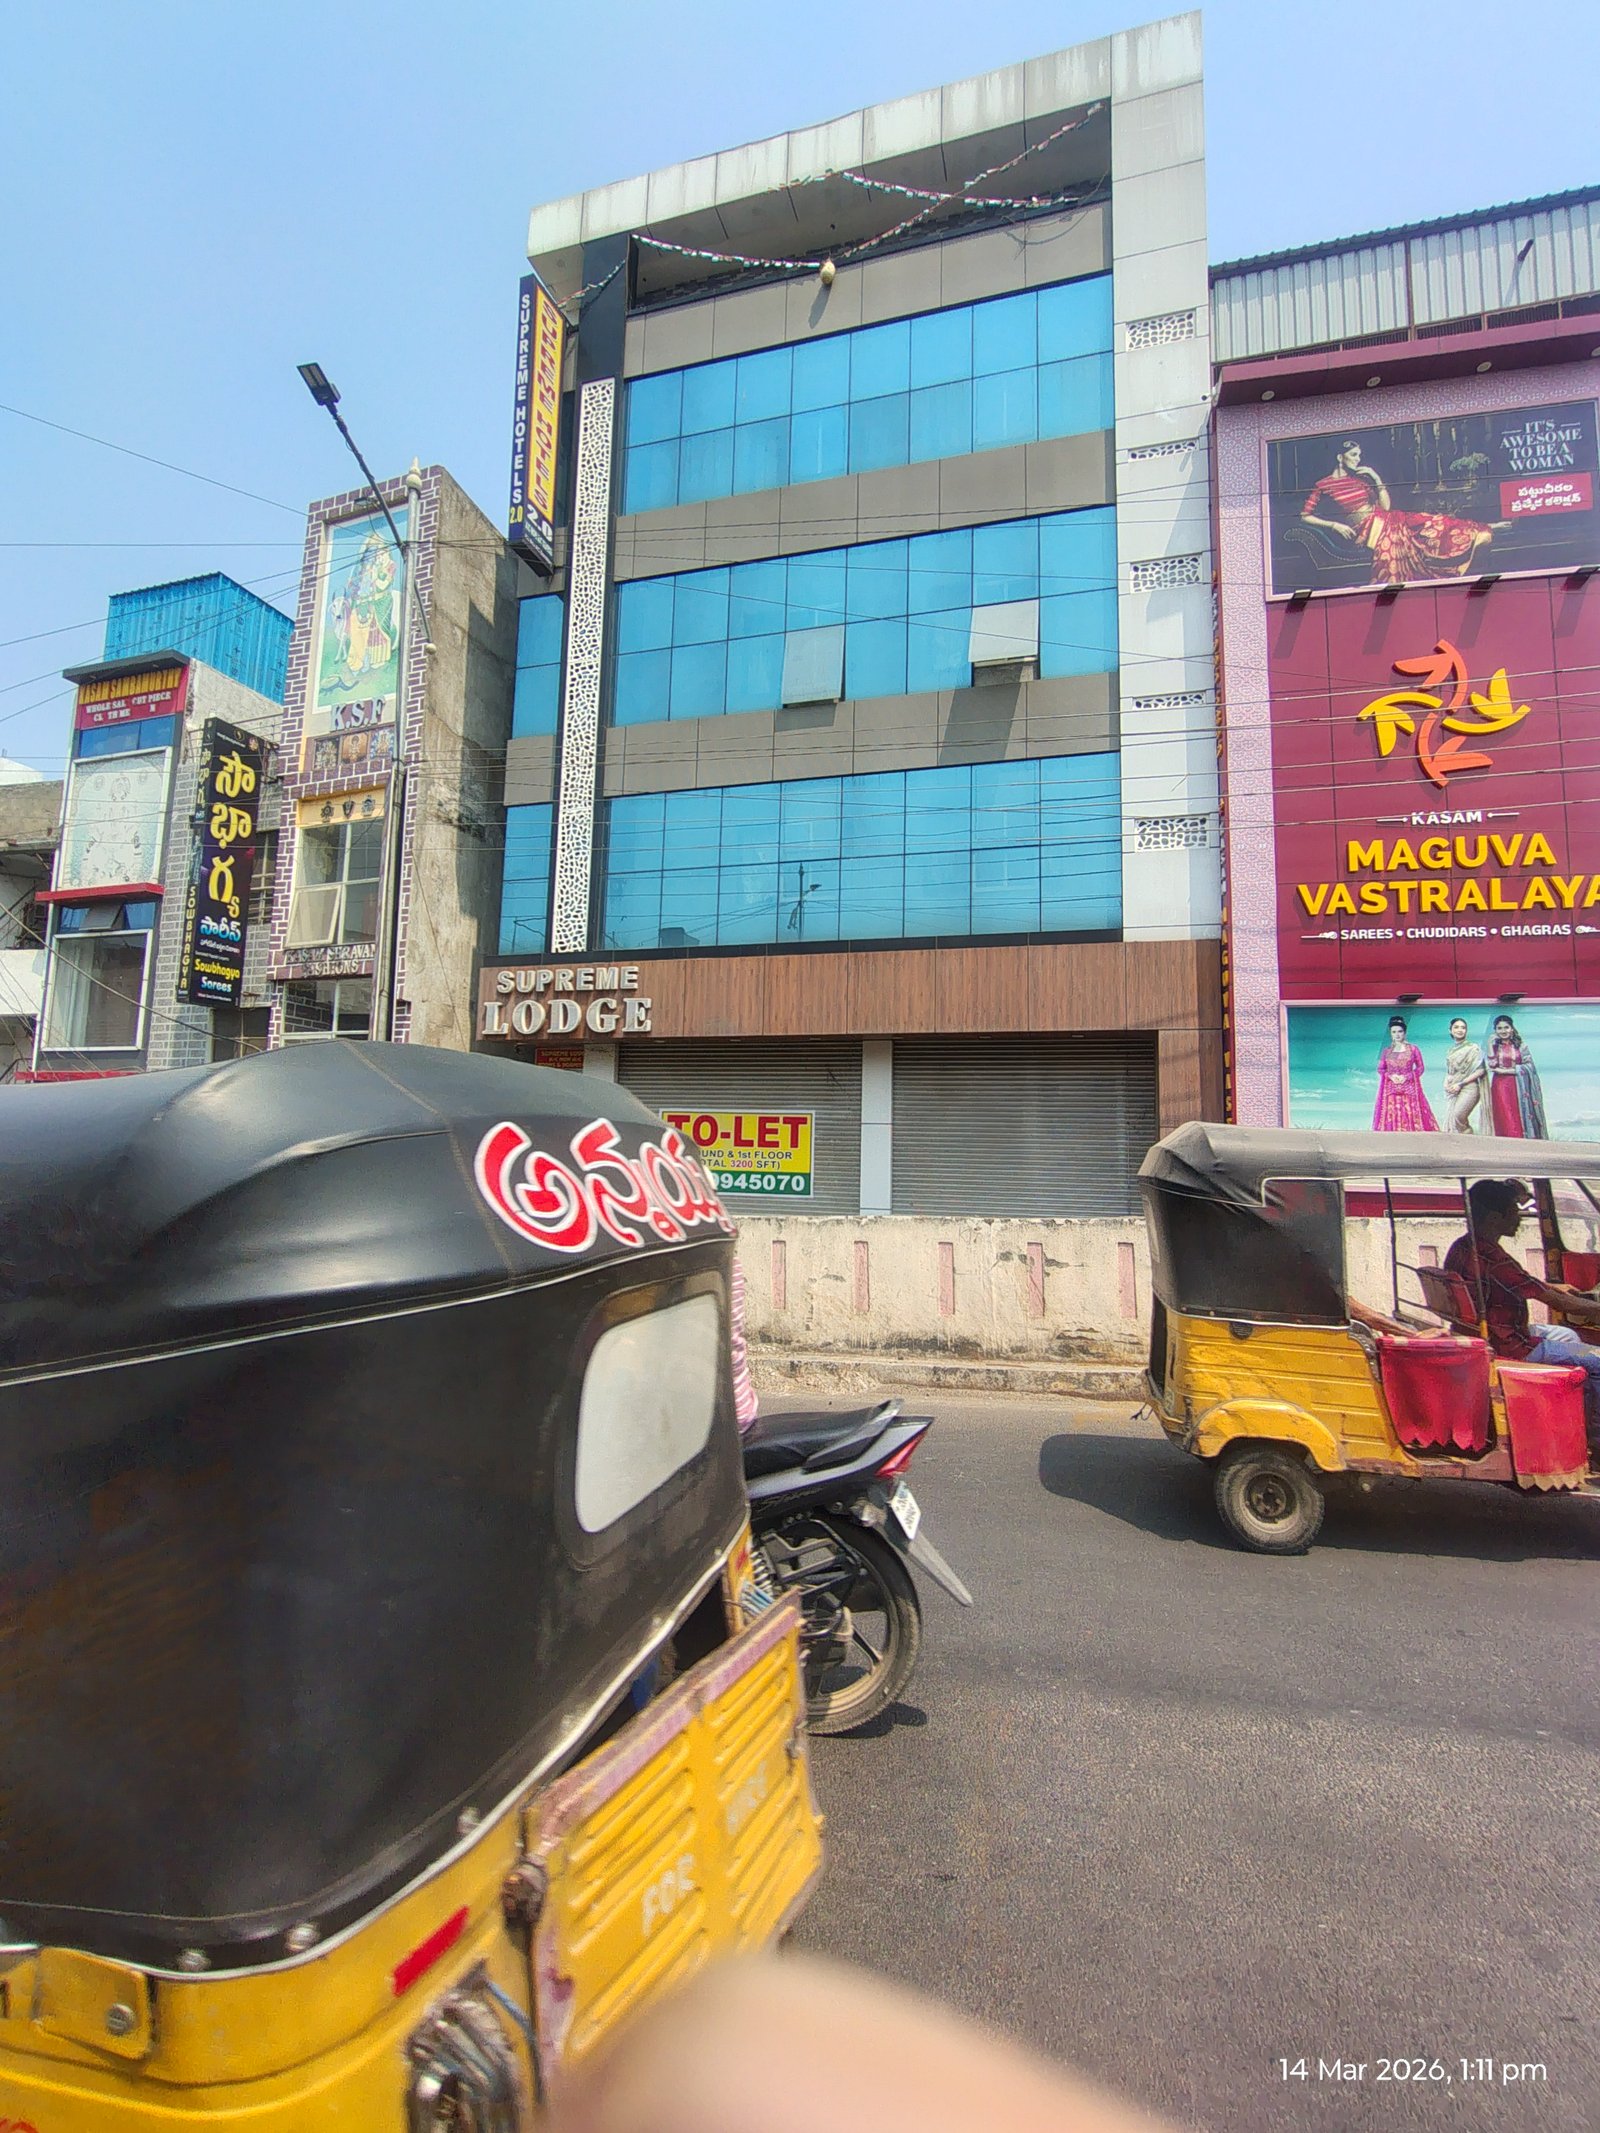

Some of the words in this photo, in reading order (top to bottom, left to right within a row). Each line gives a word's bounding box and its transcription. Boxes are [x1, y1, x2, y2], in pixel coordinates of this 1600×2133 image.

[517, 294, 530, 401] SUPREME
[537, 300, 557, 414] SUPREME
[1525, 419, 1555, 434] IT'S
[1500, 428, 1582, 448] AWESOME
[512, 406, 526, 504] HOTELS
[534, 409, 552, 510] HOTELS
[1509, 446, 1533, 459] TO
[1536, 443, 1557, 456] BE
[1559, 442, 1570, 454] A
[1509, 453, 1574, 471] WOMAN
[510, 505, 523, 524] 2.0
[527, 504, 552, 542] 2.0
[1411, 811, 1482, 825] KASAM
[1347, 832, 1557, 872] MAGUVA
[180, 886, 196, 988] SOWBHAGYA
[1340, 928, 1393, 940] SAREES
[1406, 926, 1486, 939] CHUDIDARS
[1501, 924, 1571, 937] GHAGRAS
[195, 958, 240, 980] Sowbhagya
[497, 965, 639, 993] SUPREME
[201, 976, 232, 992] Sarees
[482, 998, 651, 1035] LODGE
[667, 1114, 808, 1149] TO-LET
[699, 1150, 724, 1158] UND
[728, 1150, 734, 1158] &
[738, 1150, 751, 1159] 1st
[754, 1151, 792, 1160] FLOOR
[730, 1159, 753, 1169] 3200
[756, 1160, 781, 1170] SFT)
